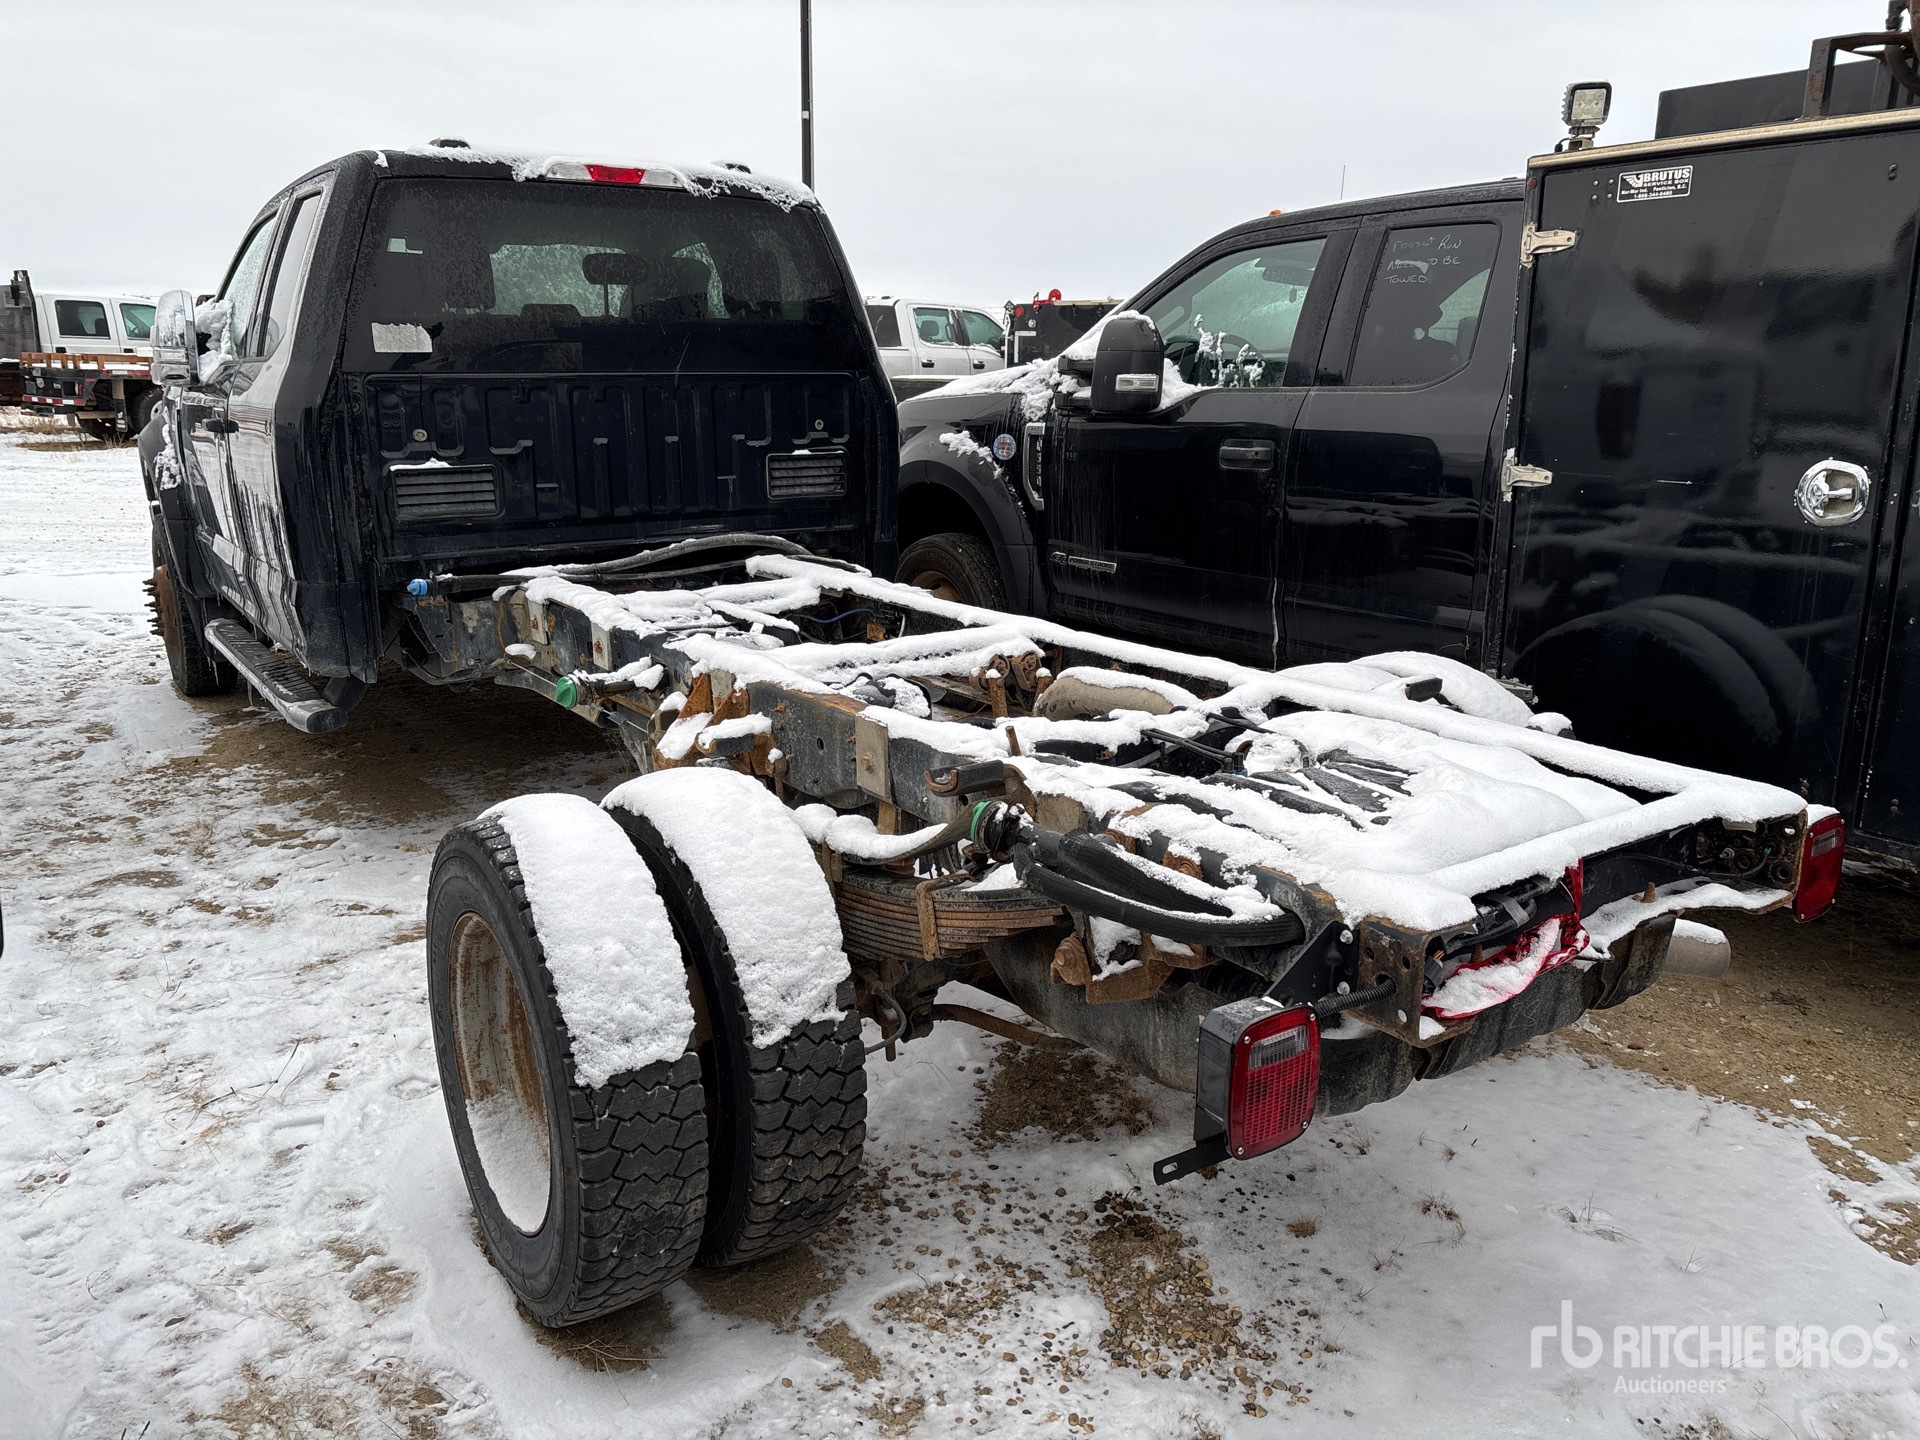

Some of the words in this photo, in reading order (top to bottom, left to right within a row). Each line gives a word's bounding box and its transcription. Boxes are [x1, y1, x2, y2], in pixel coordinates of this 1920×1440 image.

[1644, 169, 1690, 181] BRUTUS
[1442, 255, 1461, 265] BE
[1384, 274, 1428, 283] TOWED
